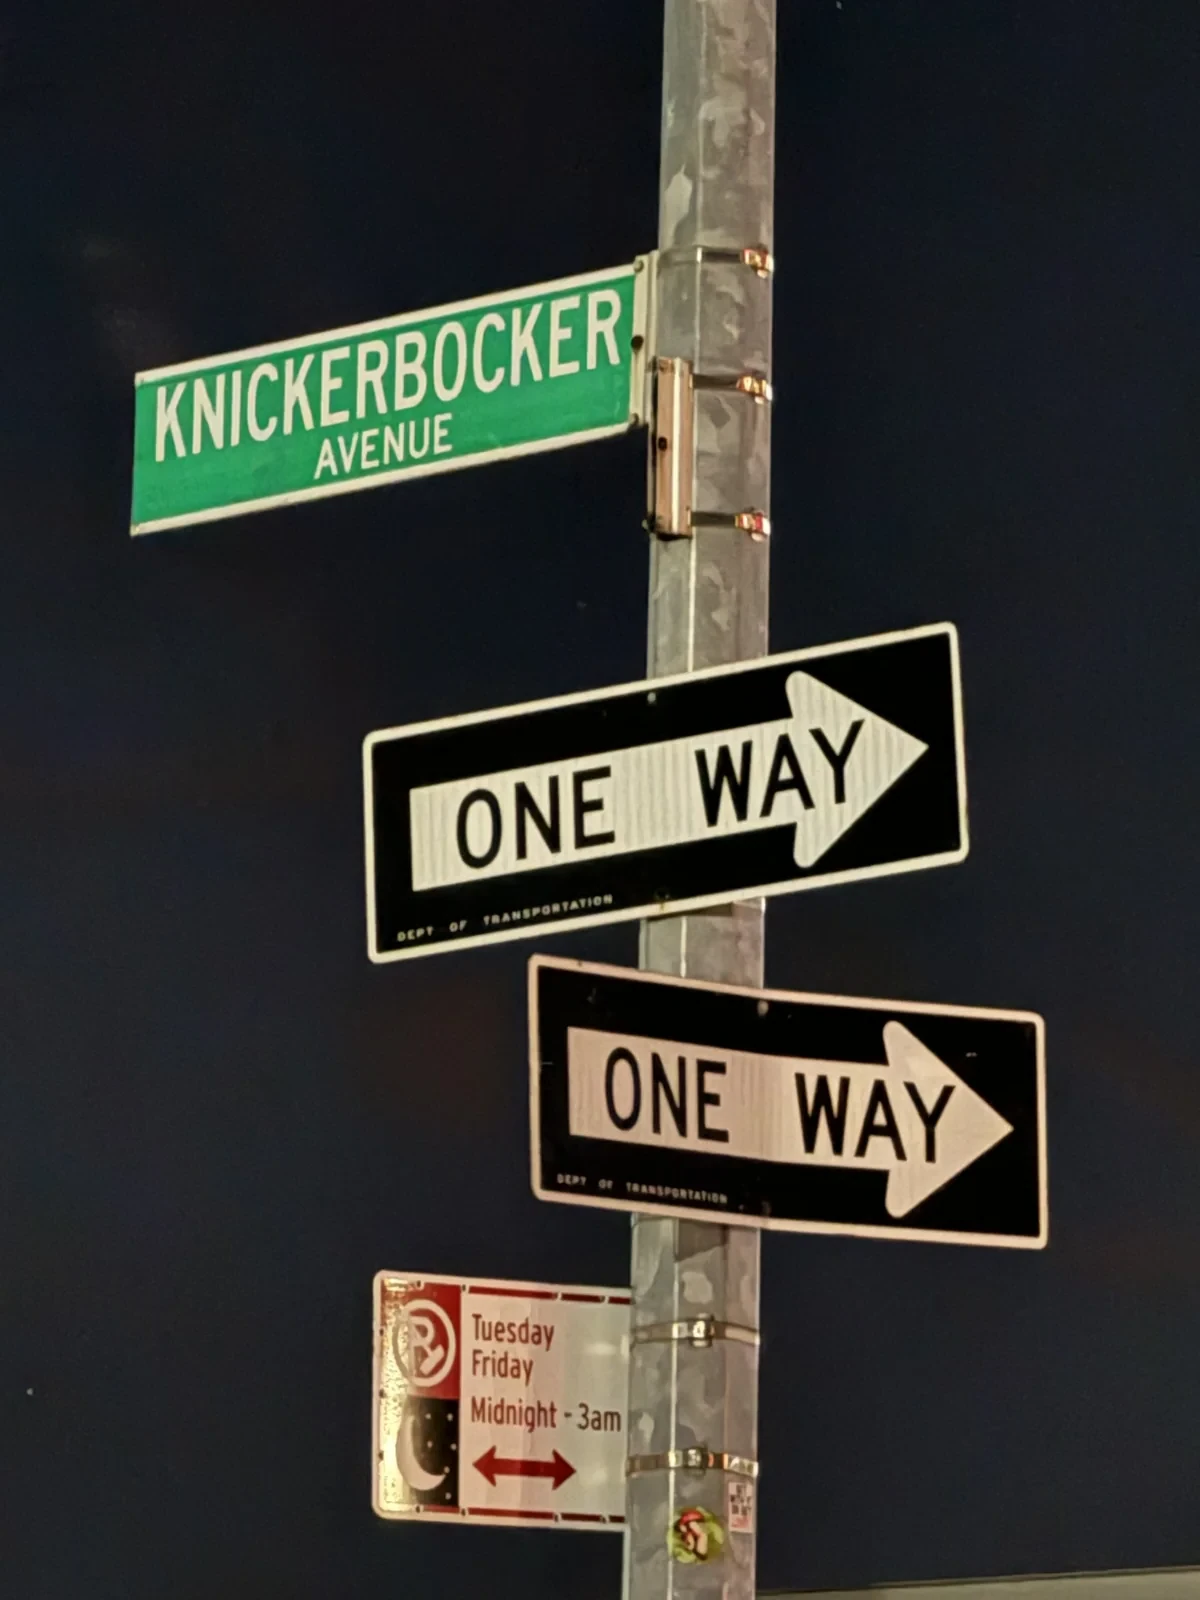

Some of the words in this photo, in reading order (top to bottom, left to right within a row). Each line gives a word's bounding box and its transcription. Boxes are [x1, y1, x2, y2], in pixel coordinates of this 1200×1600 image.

[154, 288, 622, 462] KNICKERBOCKER
[313, 412, 453, 480] AVENUE
[455, 765, 616, 870] ONE
[694, 718, 866, 828] WAY
[396, 926, 434, 942] DEPT
[449, 919, 468, 933] OF
[483, 894, 614, 926] TRANSPORTATION
[604, 1046, 730, 1143] ONE
[794, 1070, 956, 1164] WAY
[556, 1173, 587, 1186] DEPT
[598, 1179, 613, 1189] OF
[626, 1182, 729, 1205] TRANSPORTATION
[471, 1313, 555, 1352] Tuesday
[472, 1349, 534, 1387] Friday
[470, 1396, 558, 1433] Midnight
[576, 1402, 622, 1432] 3am
